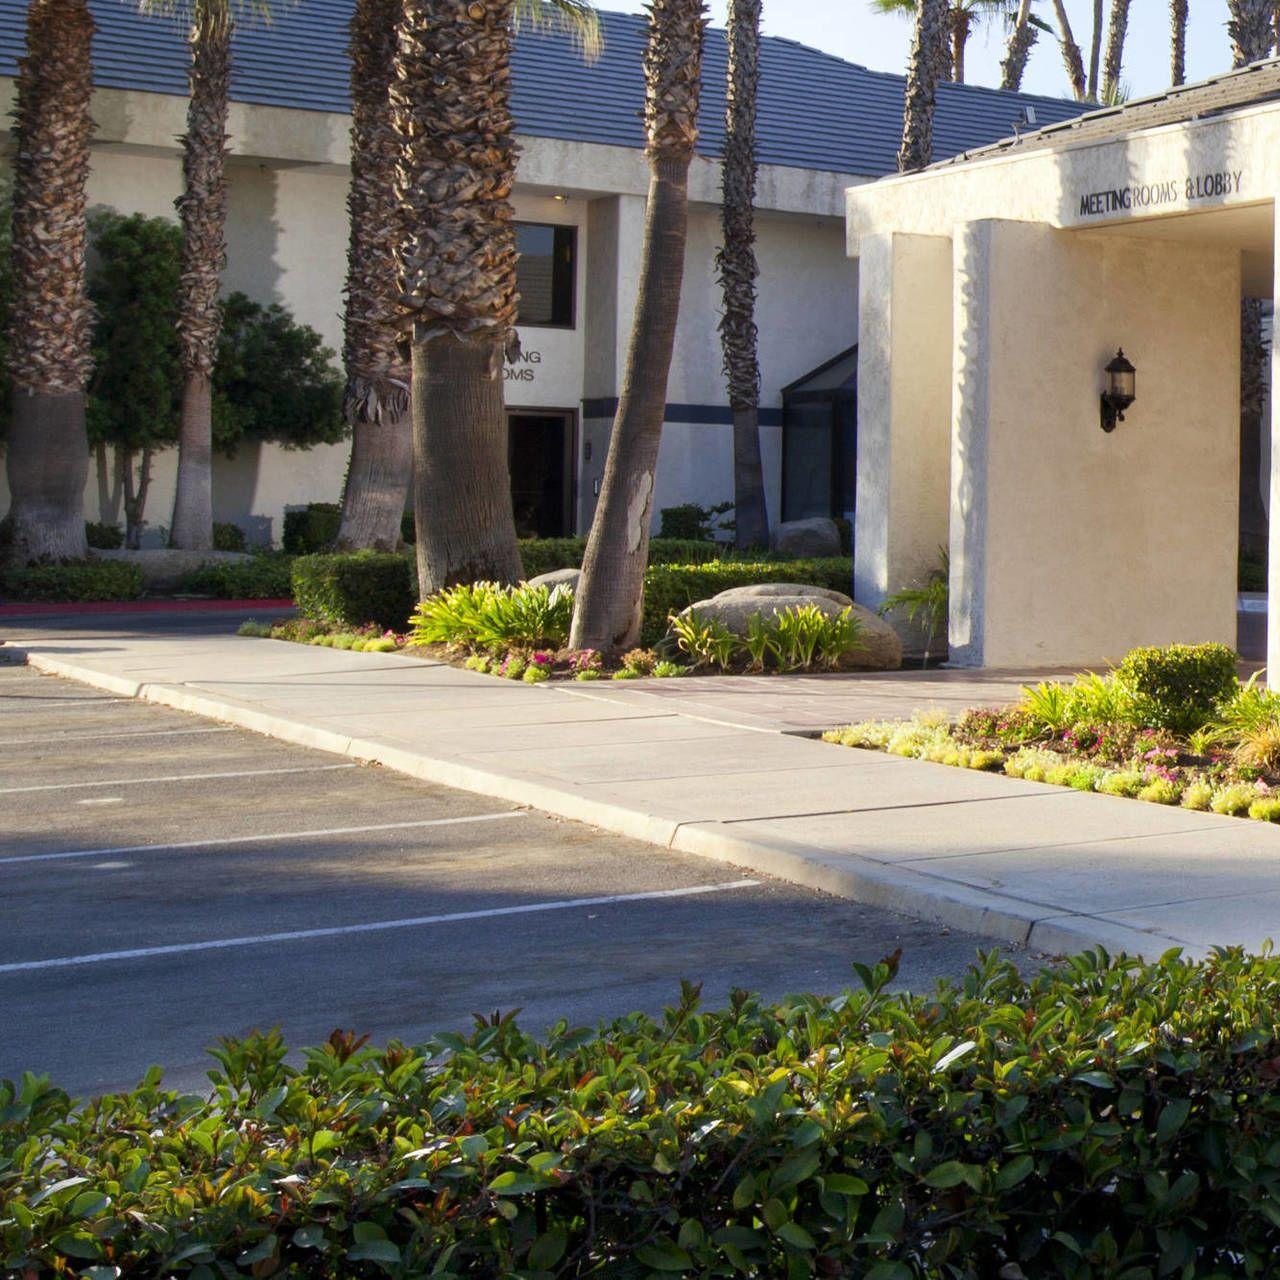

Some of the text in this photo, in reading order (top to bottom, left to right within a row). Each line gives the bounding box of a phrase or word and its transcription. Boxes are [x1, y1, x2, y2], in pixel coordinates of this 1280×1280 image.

[1080, 170, 1242, 216] MEETING ROOMS & LOBBY
